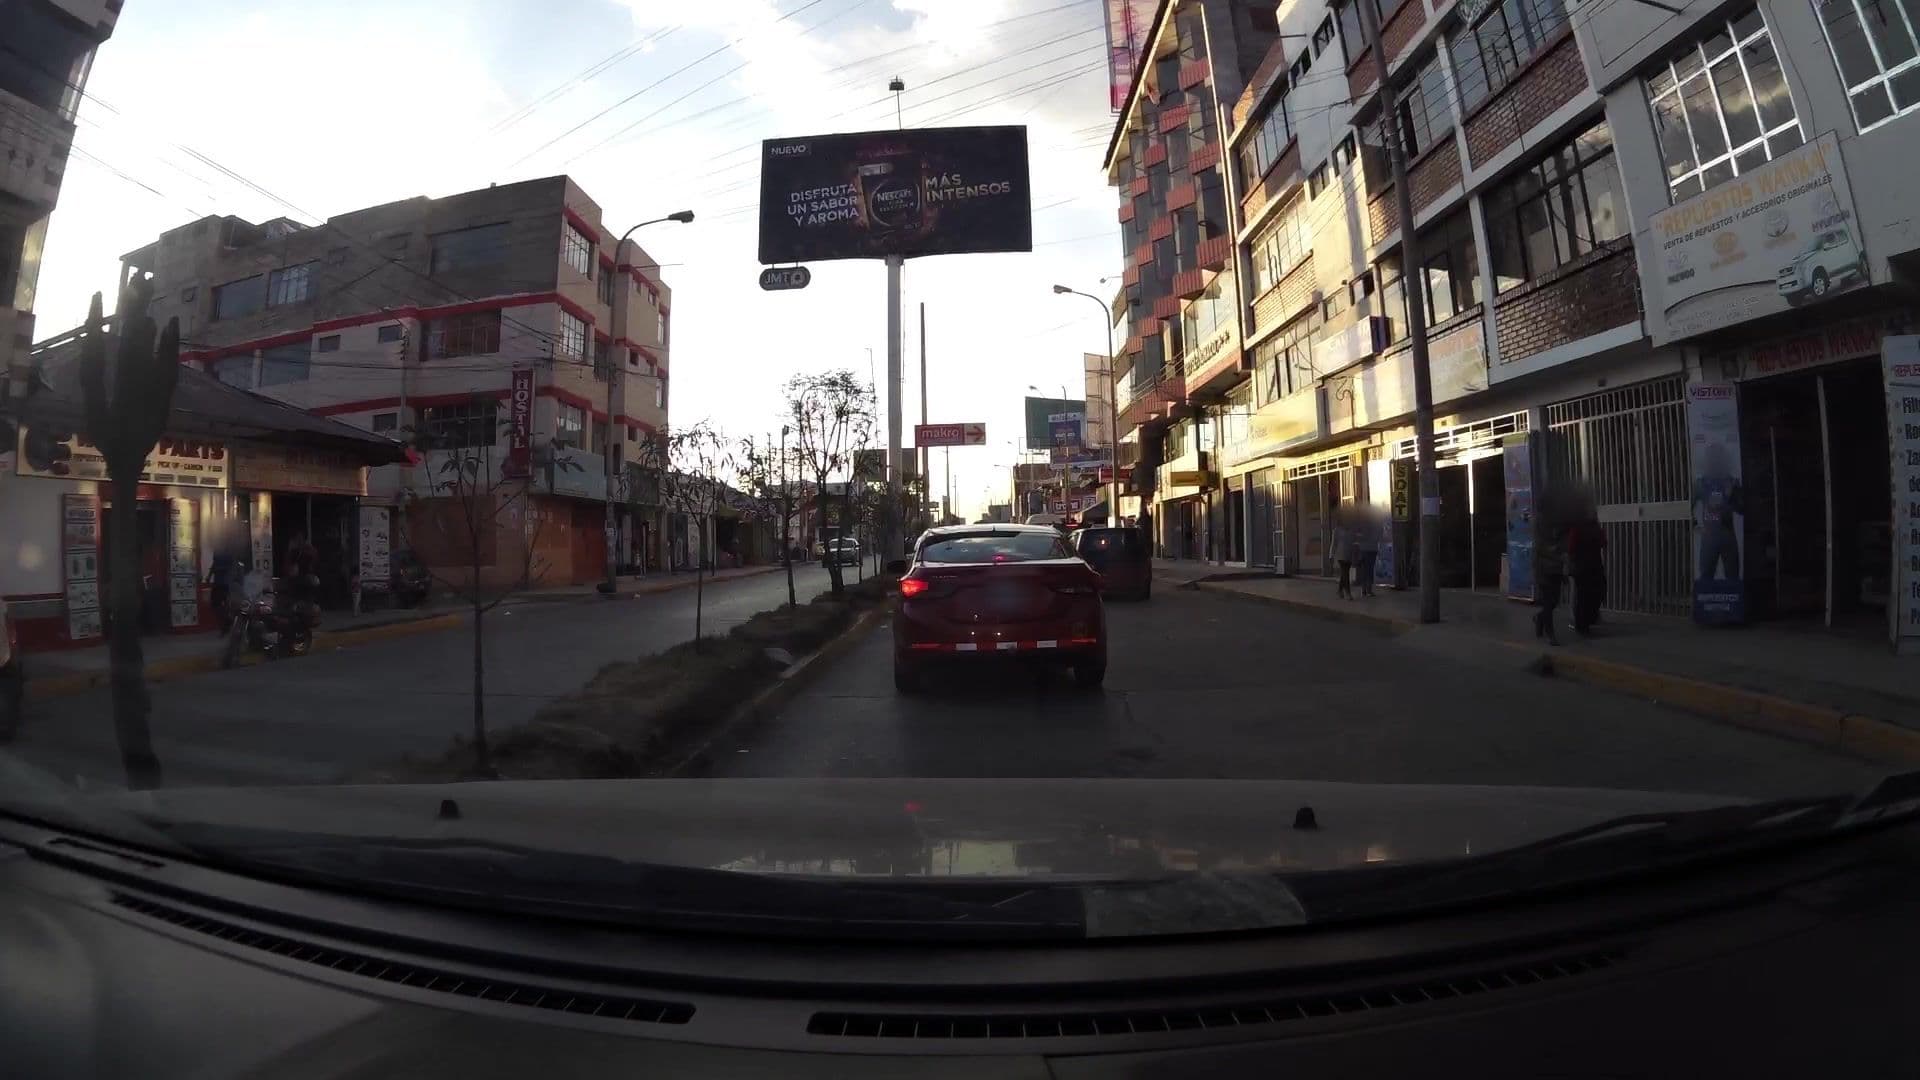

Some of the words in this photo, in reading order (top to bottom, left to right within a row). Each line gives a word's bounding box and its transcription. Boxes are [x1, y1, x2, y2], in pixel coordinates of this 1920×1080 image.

[771, 144, 806, 155] NUEVO
[926, 172, 962, 189] MÁS
[791, 183, 857, 202] DISFRUTA
[926, 181, 1010, 202] INTENSOS
[788, 203, 807, 215] UN
[811, 196, 858, 212] SABOR
[1664, 238, 1684, 250] VENTA
[1685, 233, 1694, 242] DE
[1695, 216, 1733, 237] REPUESTOS
[1742, 193, 1787, 218] ACCESORIOS
[1788, 174, 1833, 199] ORIGINALES
[795, 215, 803, 227] Y
[808, 208, 859, 224] AROMA
[515, 379, 529, 449] HOSTAL
[921, 426, 960, 438] makro
